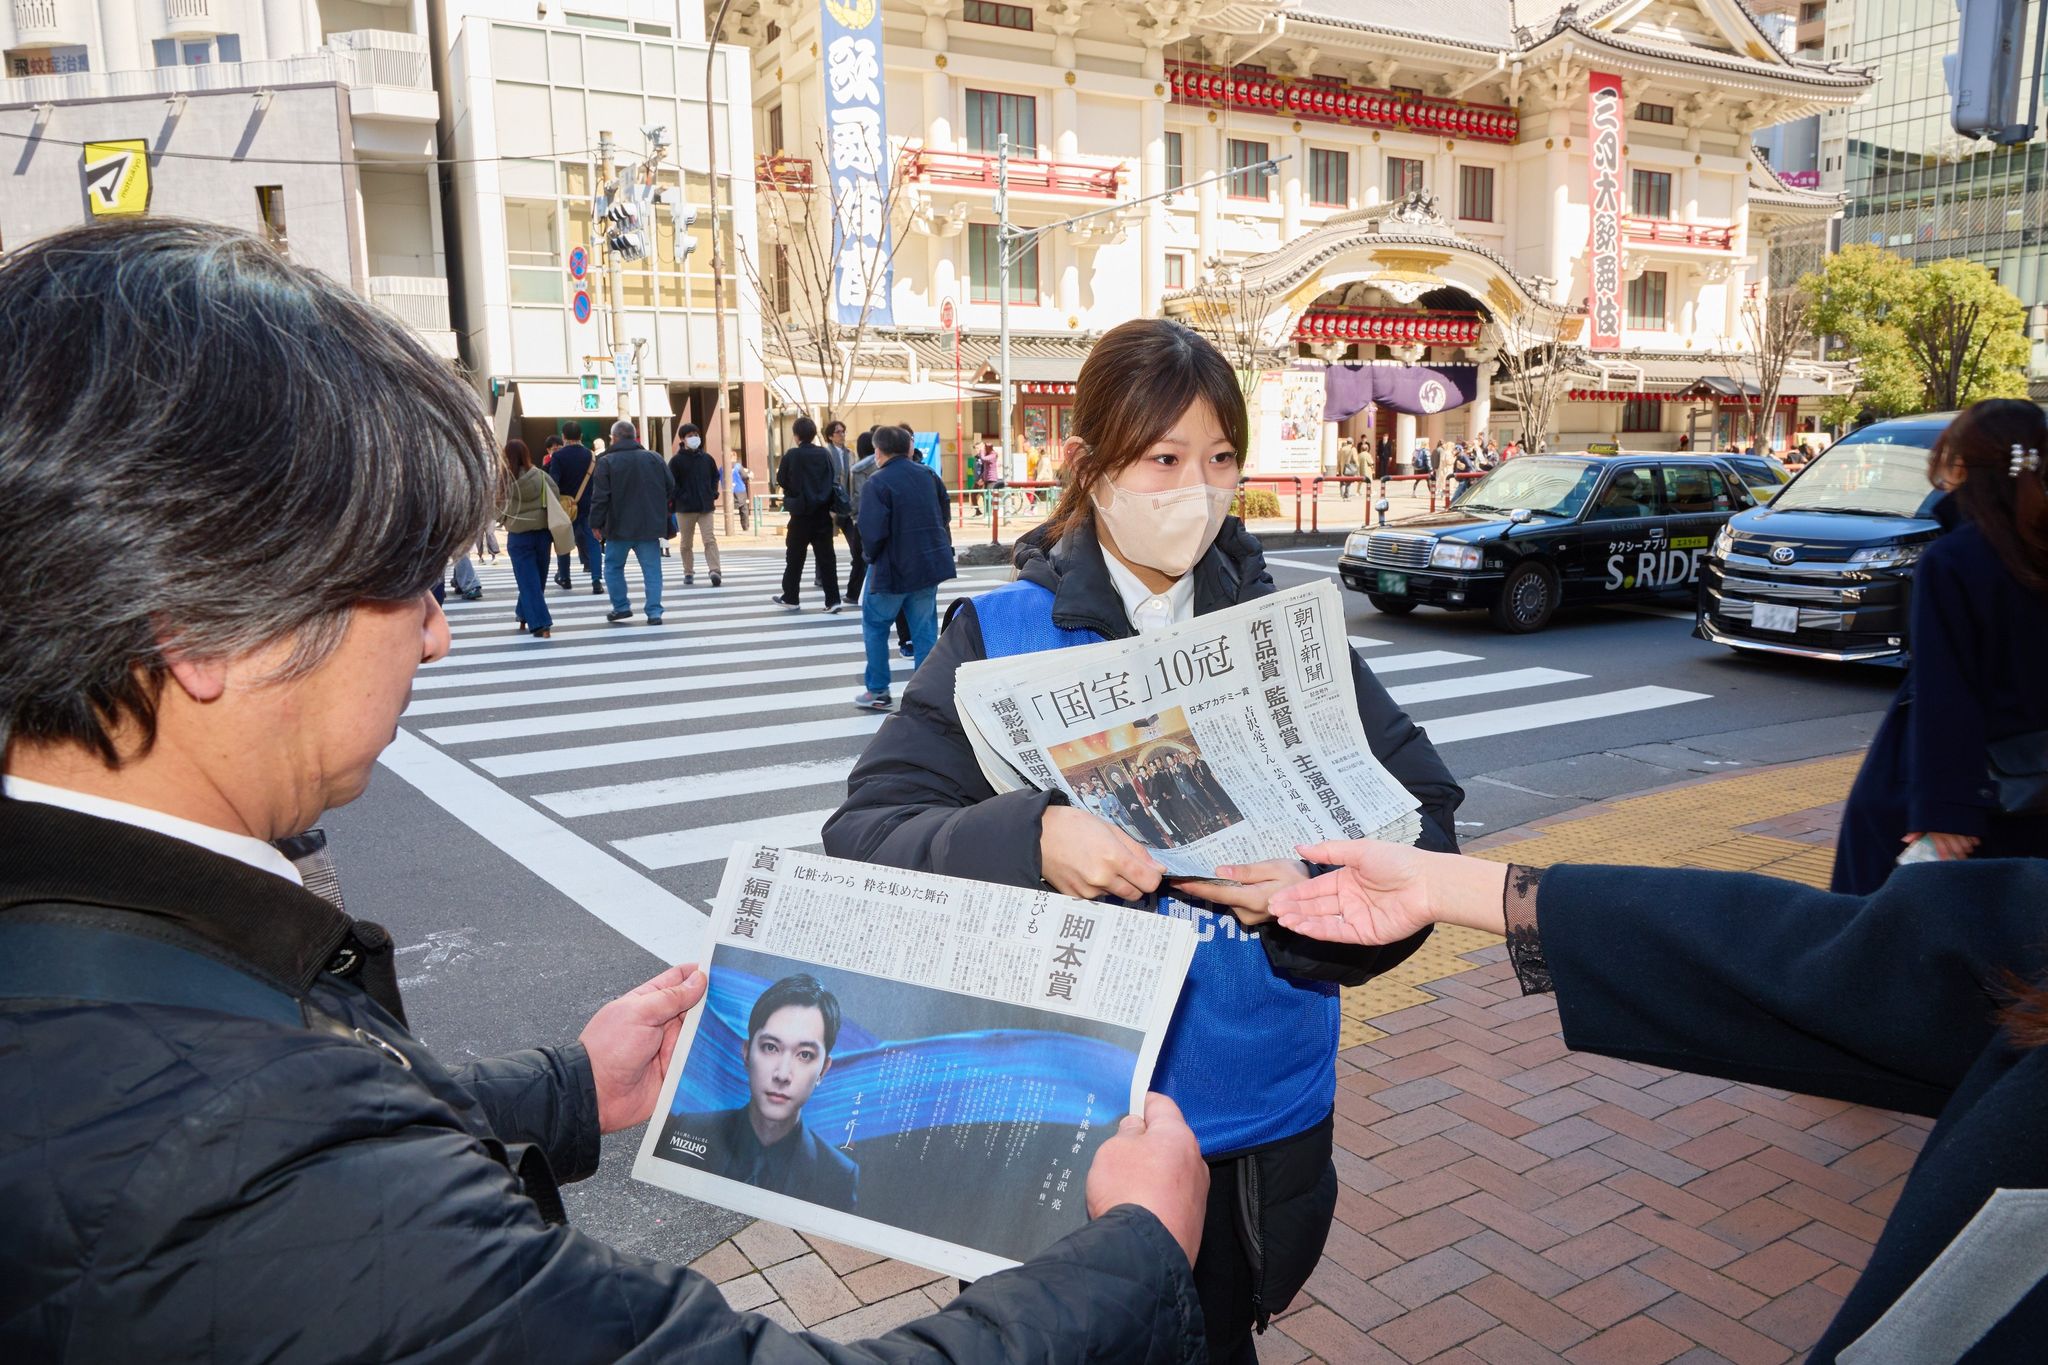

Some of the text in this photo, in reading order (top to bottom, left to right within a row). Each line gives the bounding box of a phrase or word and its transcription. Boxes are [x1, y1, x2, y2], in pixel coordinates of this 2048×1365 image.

[1593, 87, 1619, 337] 三月大歌舞伎
[1609, 539, 1667, 553] タクシーアプリ
[1250, 619, 1281, 682] 作品賞
[1293, 606, 1325, 684] 朝日新聞
[992, 697, 1032, 746] 撮影賞
[1189, 687, 1250, 715] 日本アカデミー賞
[1264, 685, 1303, 749] 監督賞
[1292, 754, 1366, 839] 主演男優賞
[731, 877, 773, 939] 編集賞
[863, 878, 949, 905] 粋を集めた舞台
[1046, 913, 1095, 1001] 脚本賞
[669, 1135, 707, 1154] MIZUHO
[1071, 1093, 1095, 1154] 青き挑戦者
[1056, 1168, 1072, 1192] 吉沢
